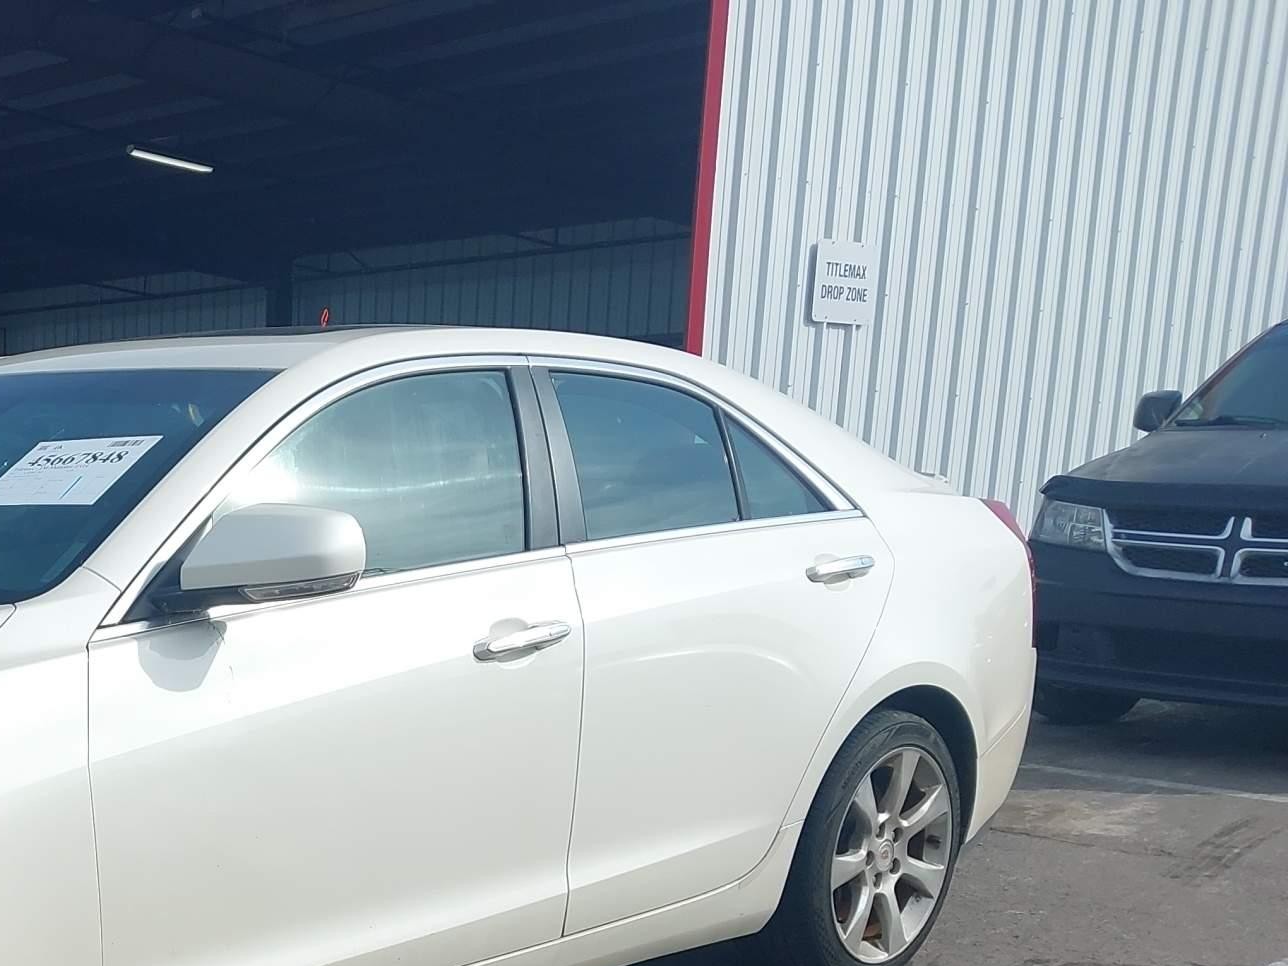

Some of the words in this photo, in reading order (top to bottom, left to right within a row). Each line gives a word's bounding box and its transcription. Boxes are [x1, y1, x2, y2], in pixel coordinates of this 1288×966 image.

[826, 261, 867, 279] TITLEMAX
[820, 284, 845, 300] DROP
[846, 286, 868, 302] ZONE
[27, 450, 130, 467] 45667848
